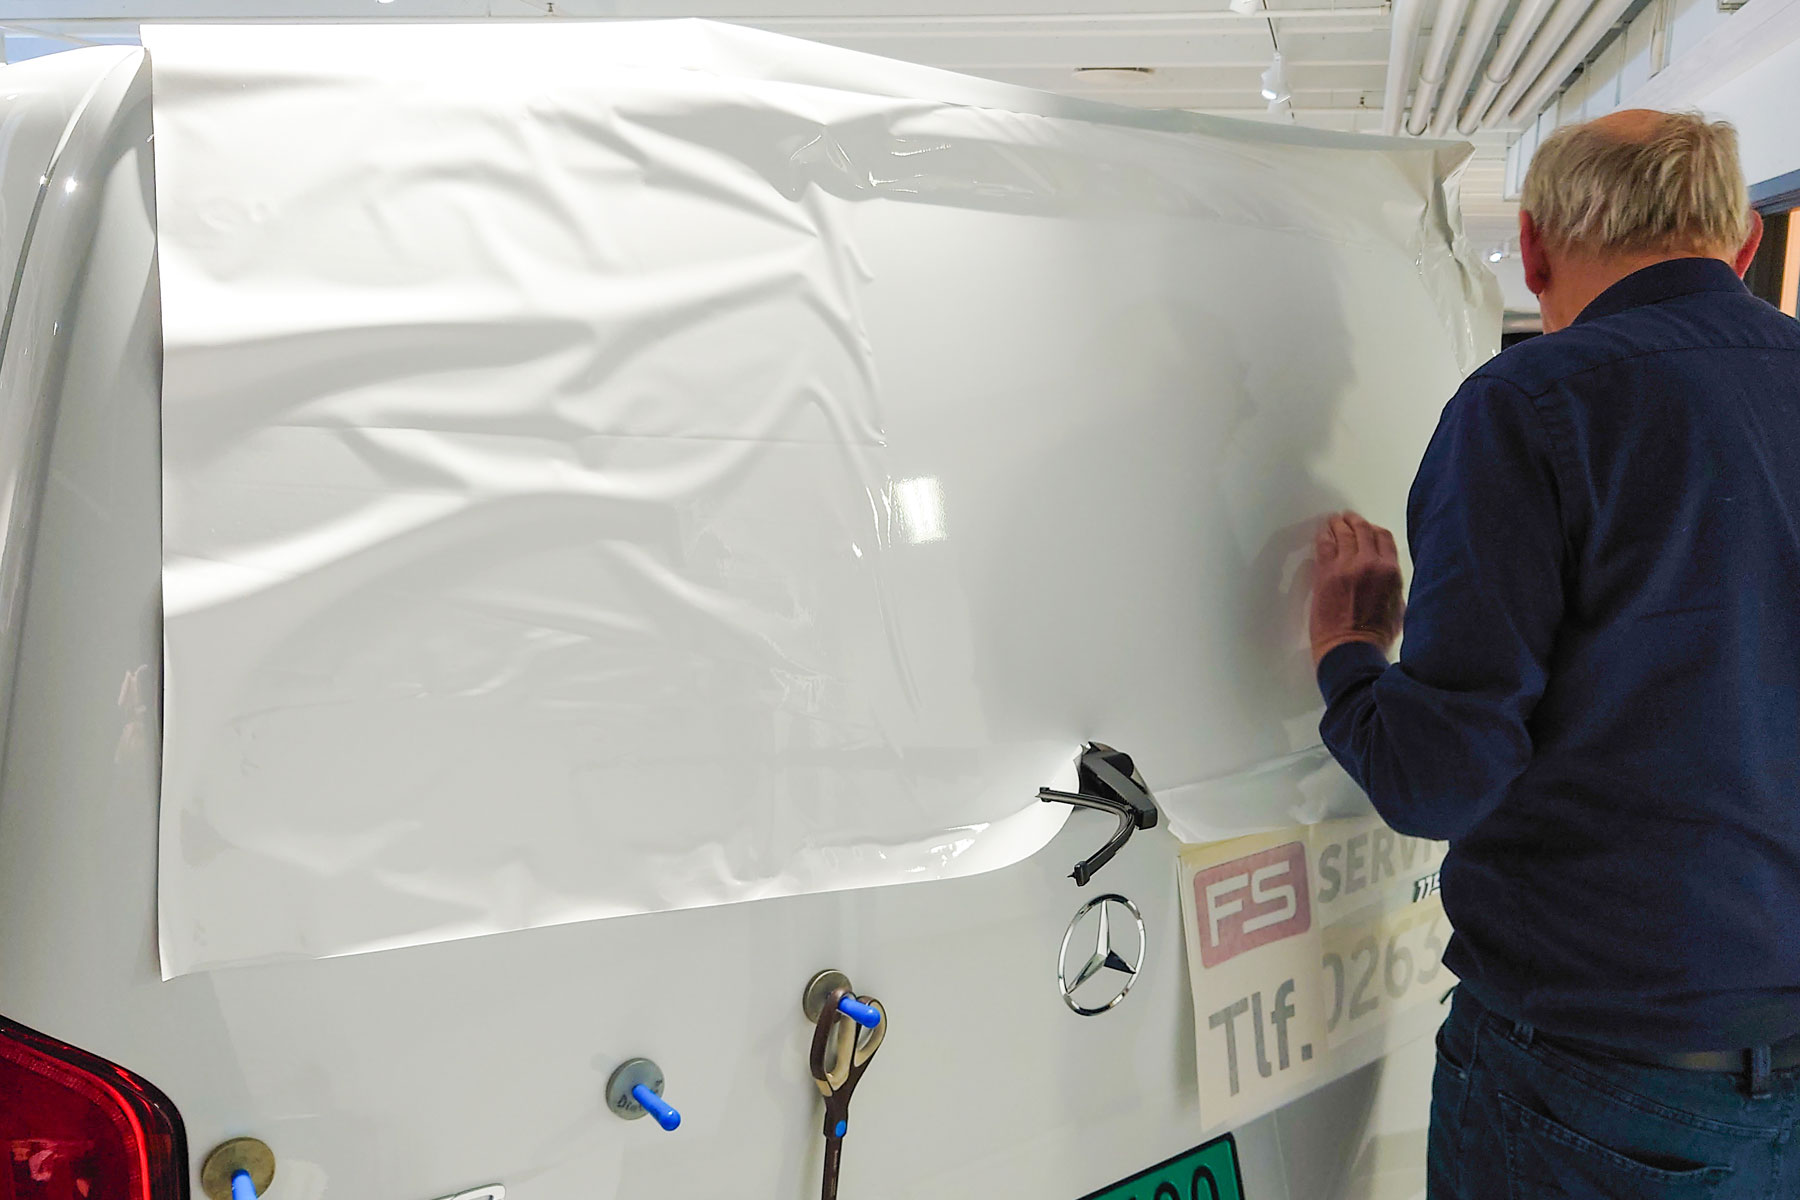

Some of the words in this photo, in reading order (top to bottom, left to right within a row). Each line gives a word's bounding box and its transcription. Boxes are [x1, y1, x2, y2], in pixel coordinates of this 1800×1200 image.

[1206, 860, 1297, 948] FS
[1318, 828, 1449, 903] SERVI
[1208, 978, 1313, 1097] Tlf.
